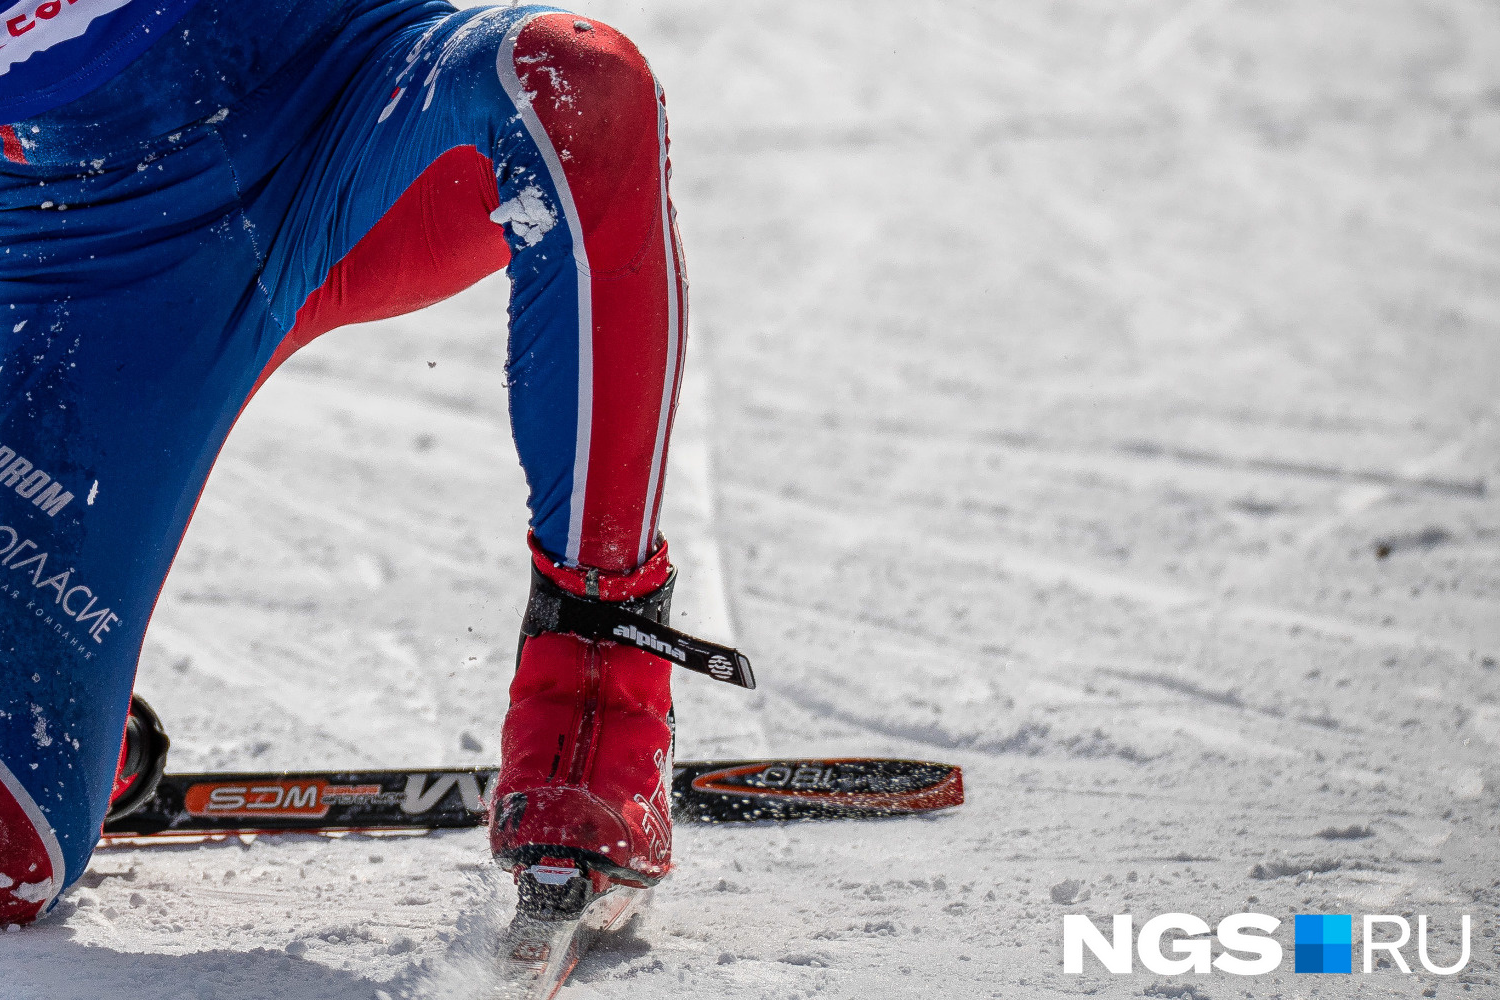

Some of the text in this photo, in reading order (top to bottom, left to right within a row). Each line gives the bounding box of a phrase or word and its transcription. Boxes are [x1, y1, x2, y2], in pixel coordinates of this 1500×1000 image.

[26, 600, 92, 660] КОМПАНИЯ
[612, 623, 687, 662] alpina
[207, 785, 318, 810] WCS
